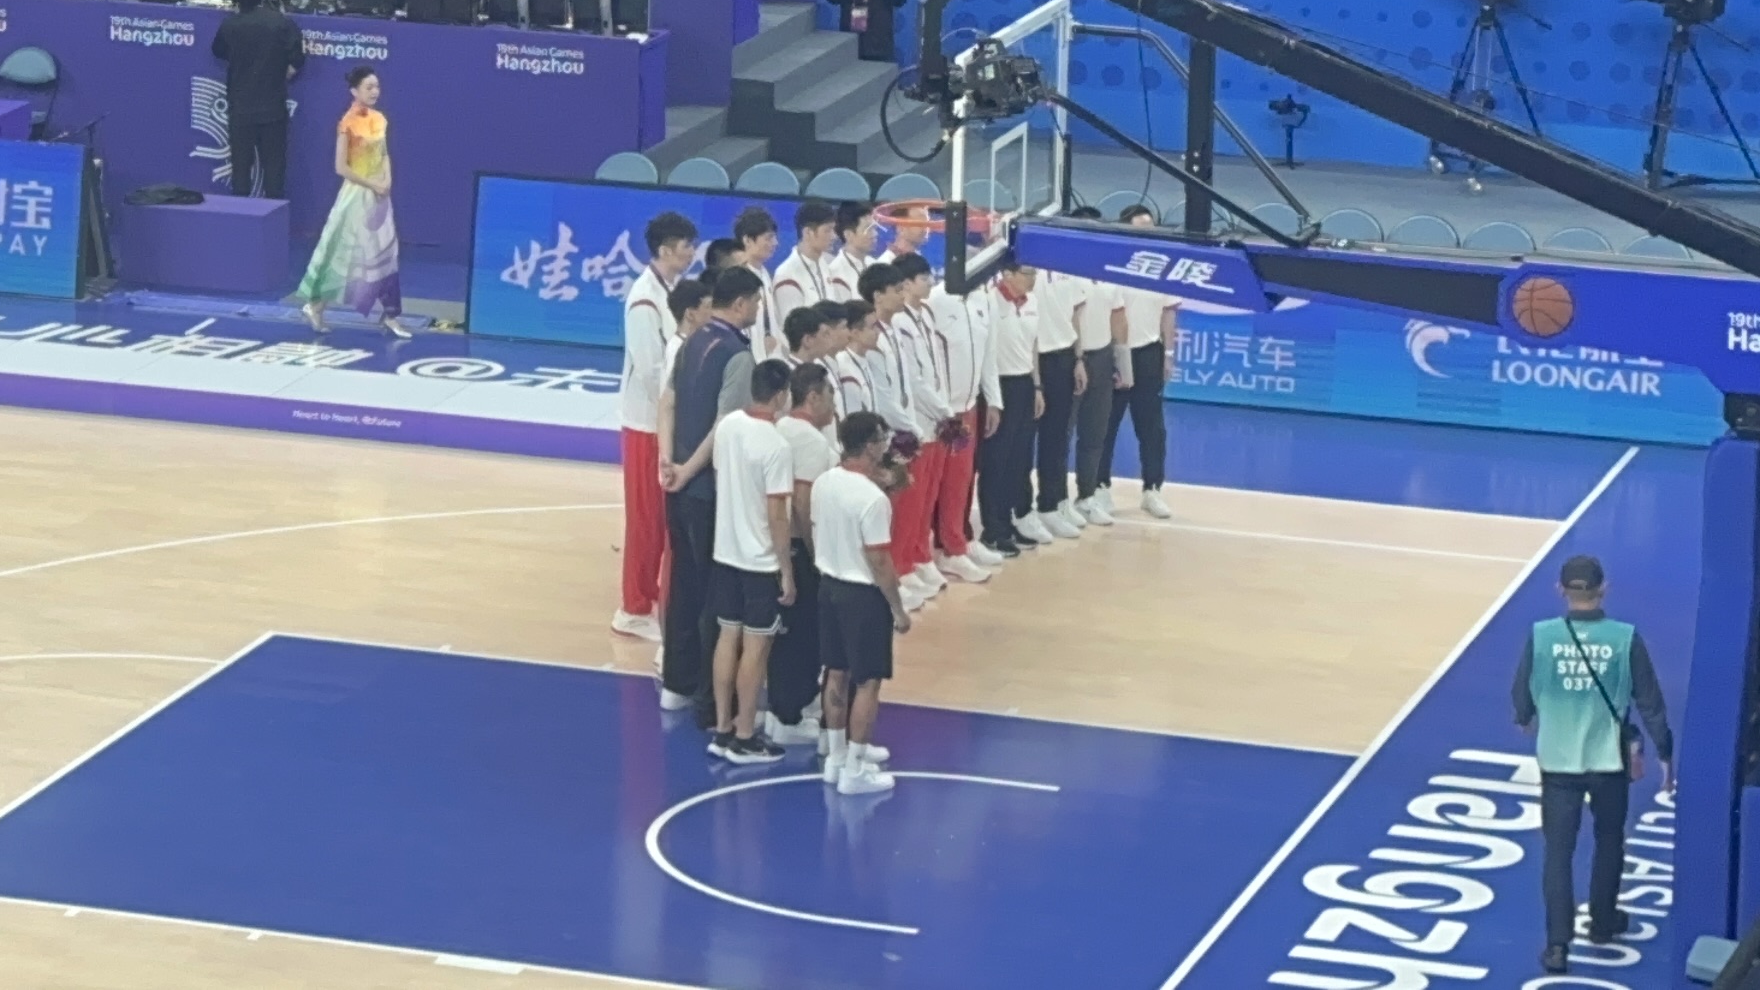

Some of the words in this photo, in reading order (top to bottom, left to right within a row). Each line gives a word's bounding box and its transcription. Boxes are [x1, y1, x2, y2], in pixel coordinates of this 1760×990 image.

[110, 16, 131, 26] 19th
[133, 17, 159, 29] Asian
[161, 19, 195, 31] Games
[110, 26, 195, 46] Hangzhou
[301, 30, 323, 41] 19th
[325, 31, 352, 43] Asian
[354, 33, 388, 45] Games
[302, 41, 388, 60] Hangzhou
[496, 43, 519, 55] 19th
[521, 45, 548, 57] Asian
[550, 47, 584, 60] Games
[496, 54, 584, 75] Hangzhou
[1105, 250, 1235, 294] 金陵
[1175, 327, 1297, 372] 利汽车
[1217, 370, 1296, 393] AUTO
[1492, 360, 1662, 397] LOONGAIR
[1552, 643, 1613, 660] PHOTO
[1557, 660, 1609, 675] STAFF
